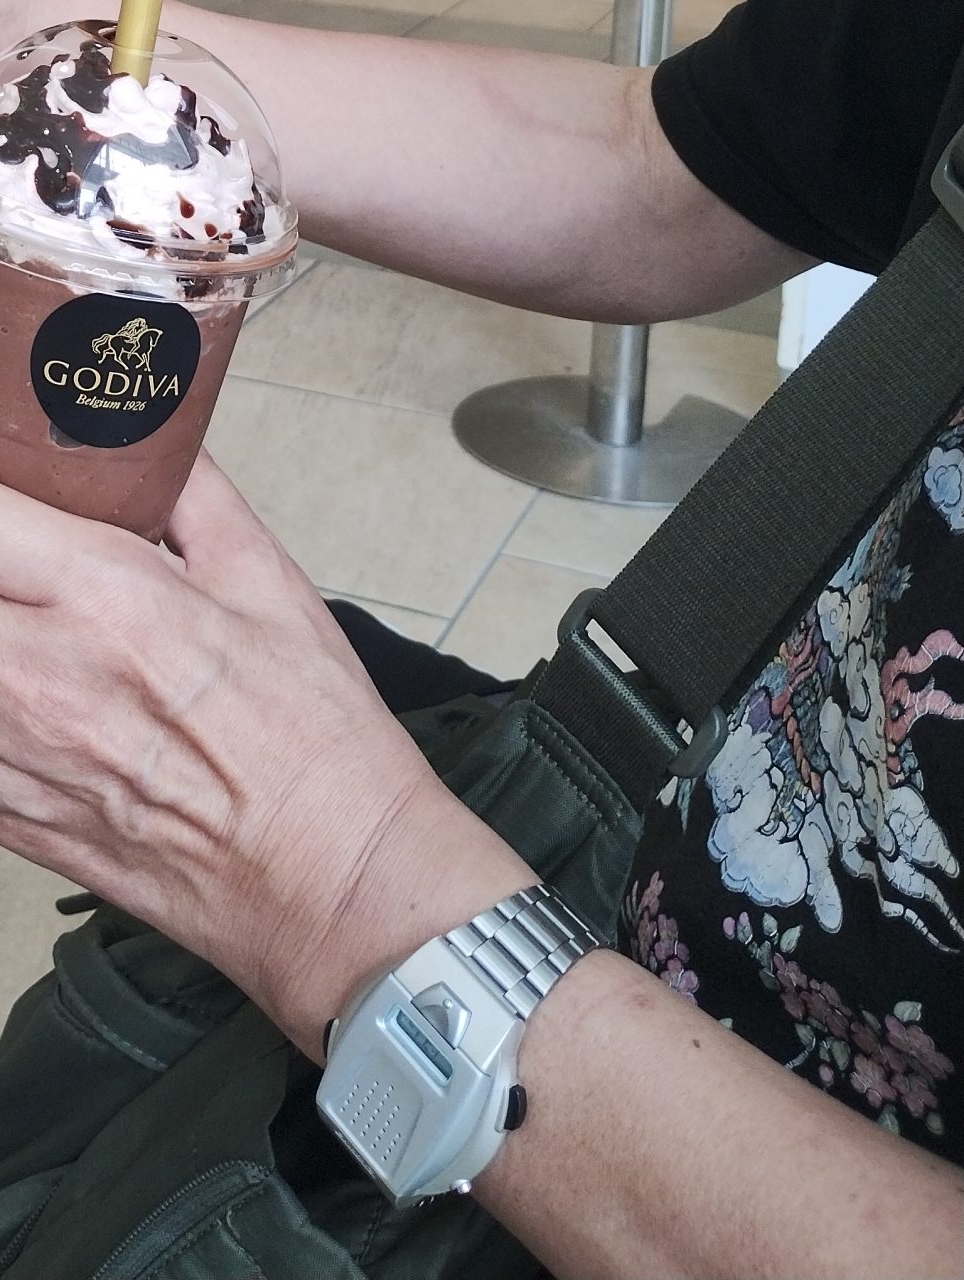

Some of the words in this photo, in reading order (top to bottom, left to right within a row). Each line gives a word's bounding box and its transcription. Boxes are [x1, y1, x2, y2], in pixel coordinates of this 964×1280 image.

[43, 360, 179, 398] GODIVA
[76, 393, 121, 411] Belgium
[122, 400, 148, 412] 1926
